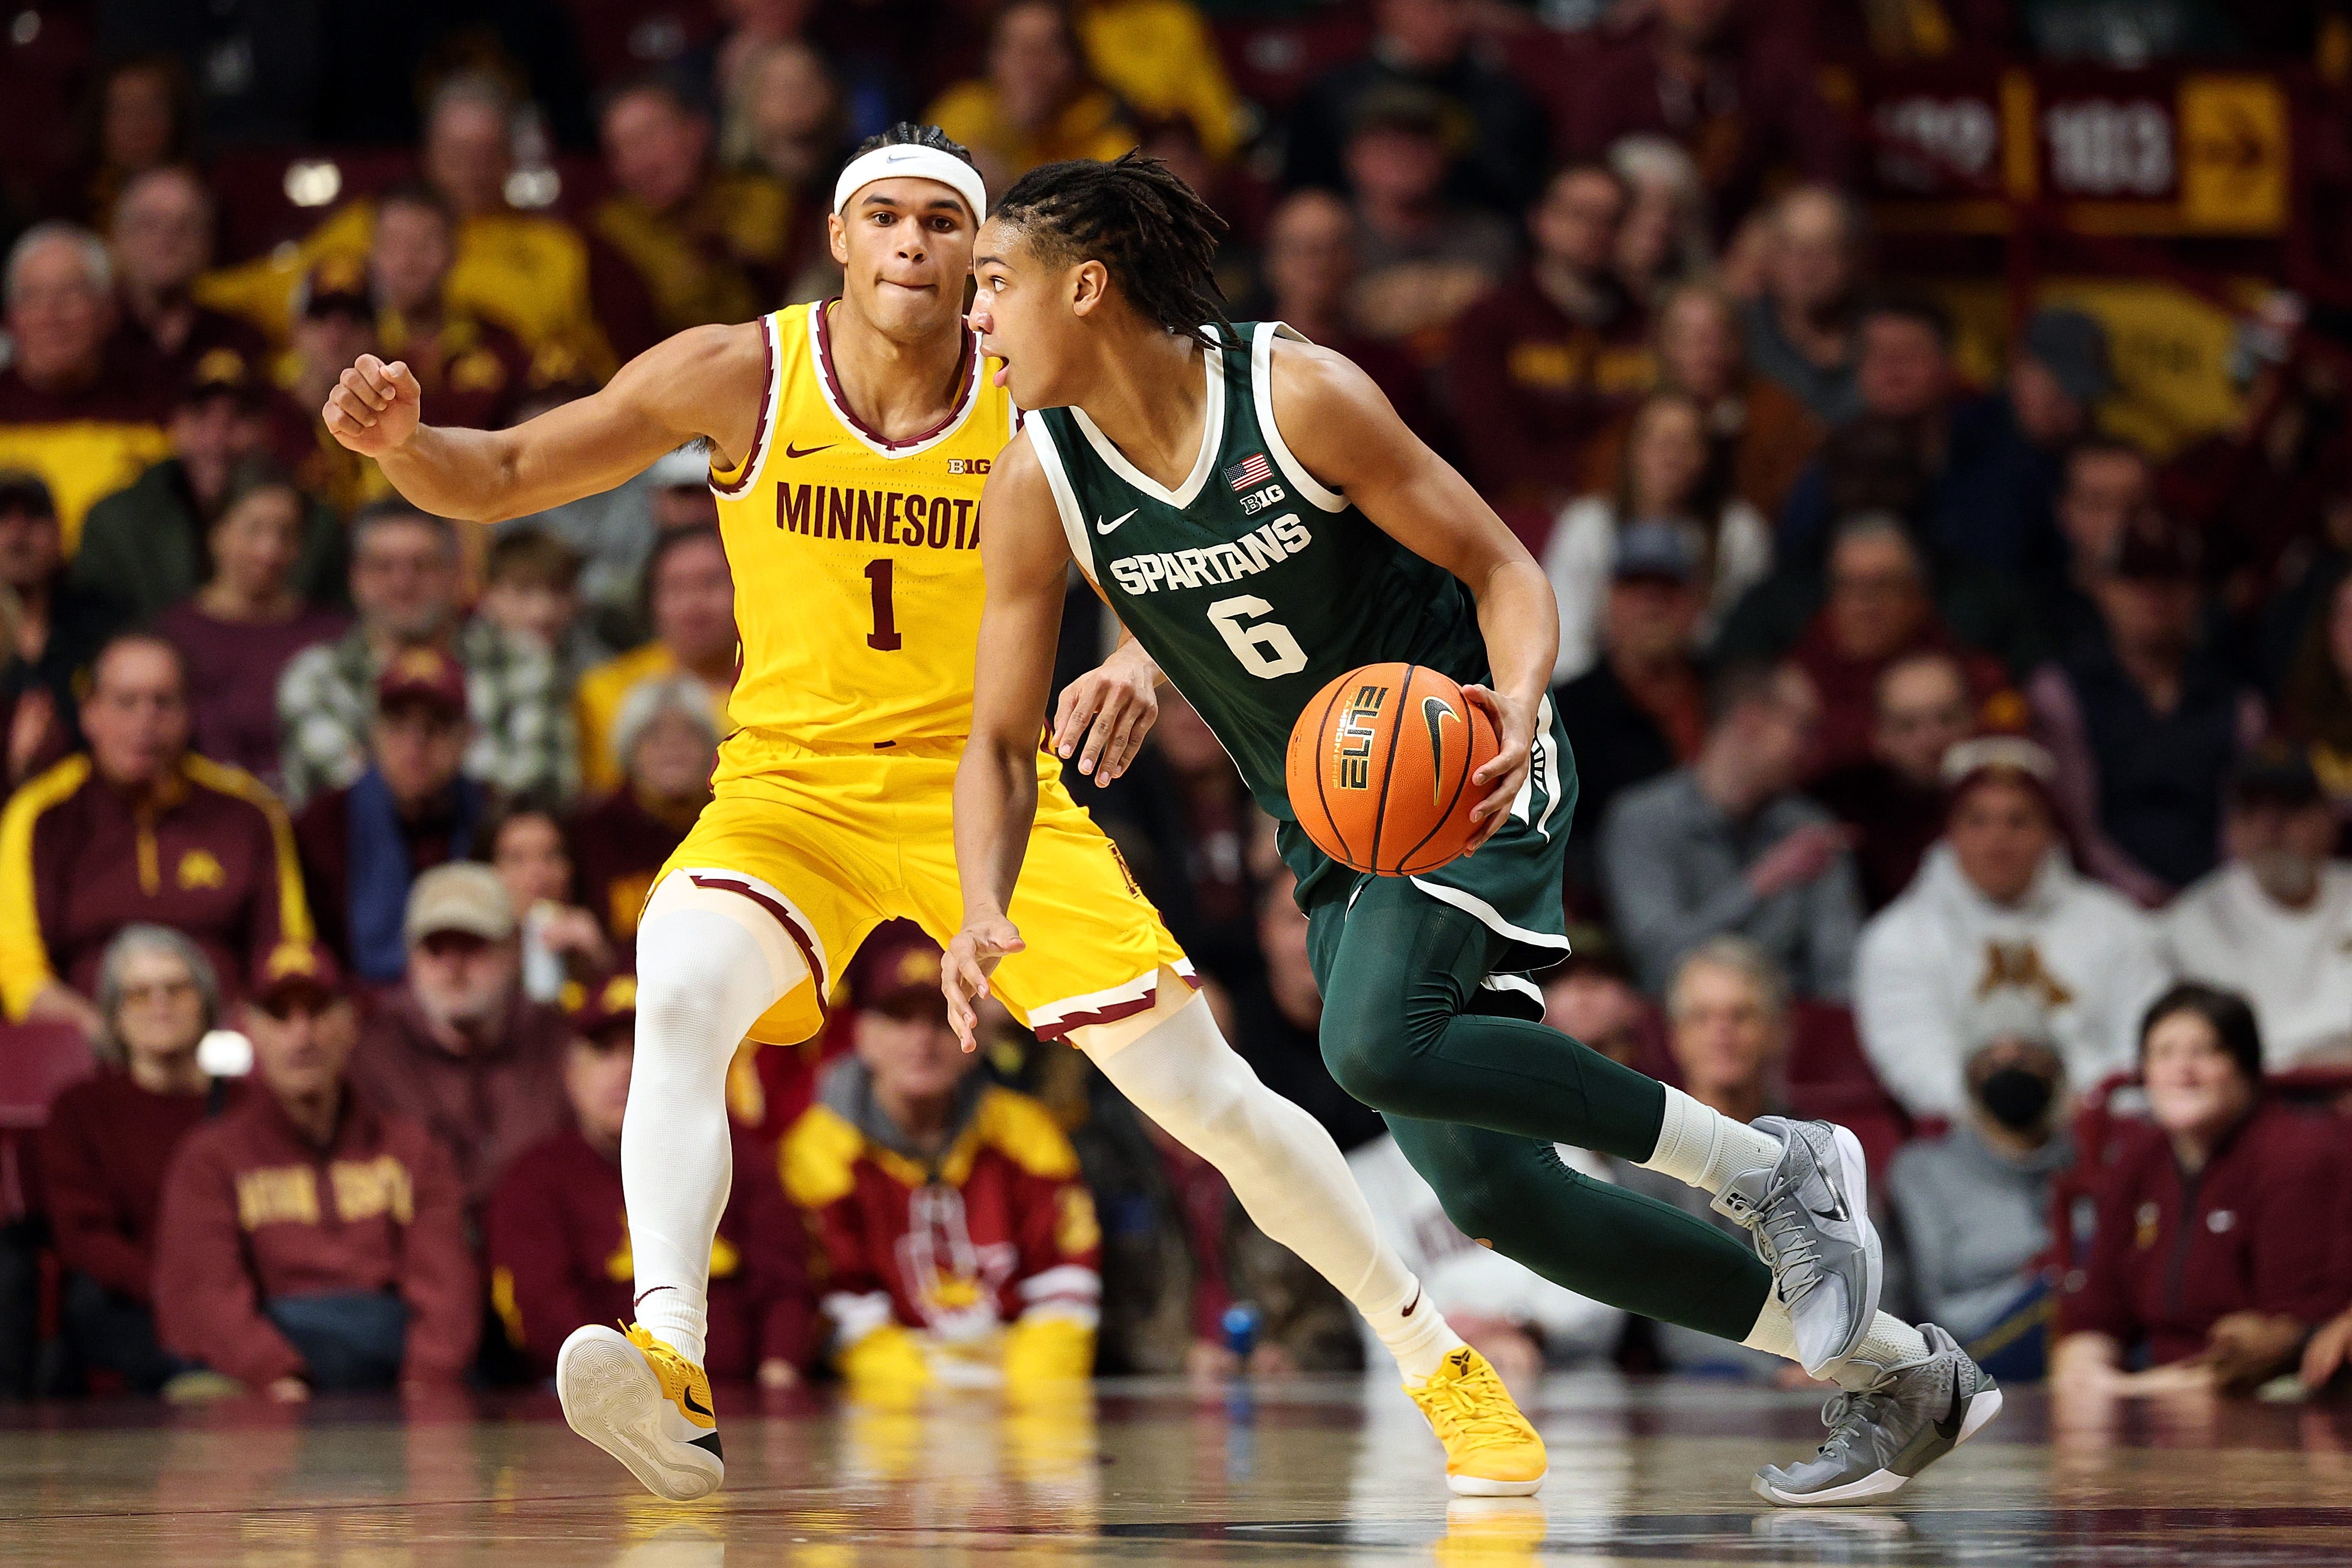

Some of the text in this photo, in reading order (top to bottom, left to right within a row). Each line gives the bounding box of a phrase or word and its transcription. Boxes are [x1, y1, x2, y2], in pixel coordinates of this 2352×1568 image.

[1110, 513, 1312, 596] SPARTANS
[864, 559, 902, 651] 1
[1206, 594, 1309, 679] 6
[1340, 686, 1389, 790] ELITE
